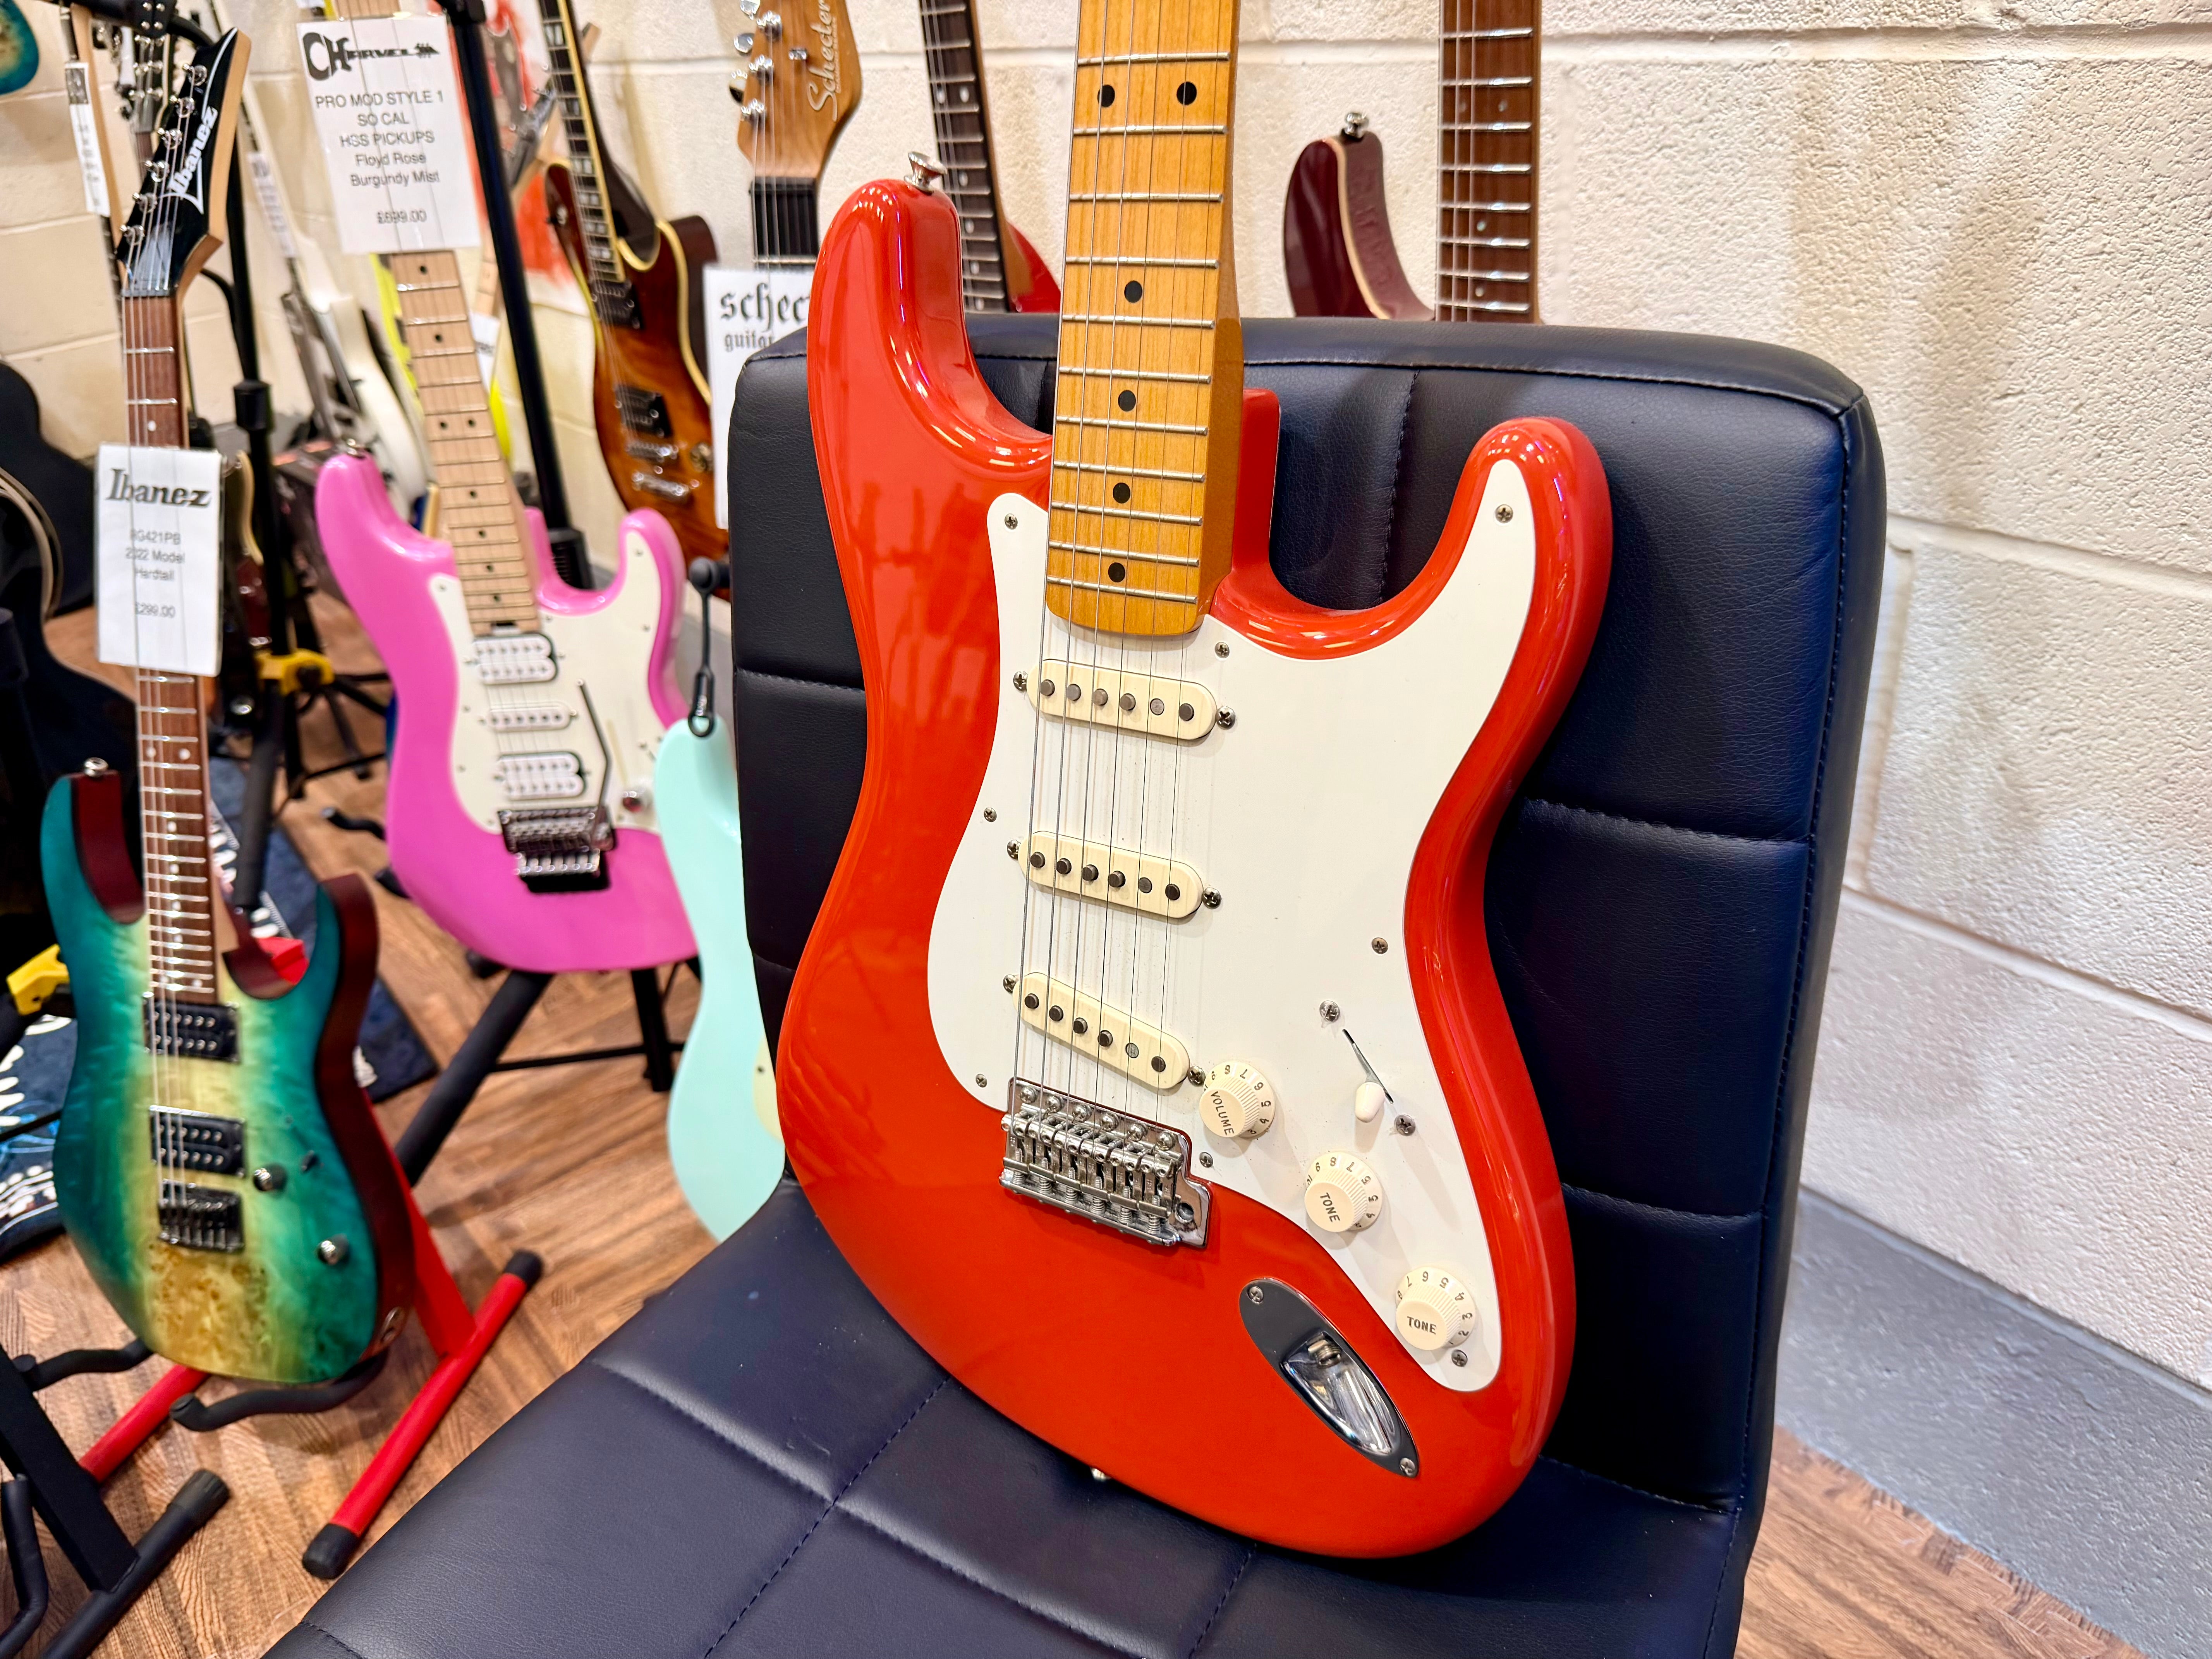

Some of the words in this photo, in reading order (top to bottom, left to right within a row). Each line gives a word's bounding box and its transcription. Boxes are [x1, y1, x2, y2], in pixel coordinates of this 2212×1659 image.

[315, 94, 347, 108] PRO
[350, 93, 383, 106] MOD
[386, 91, 432, 105] STYLE
[436, 90, 444, 103] 1
[357, 113, 378, 127] SO
[381, 111, 409, 125] CAL
[339, 134, 369, 147] HSS
[373, 130, 435, 145] PICKUPS
[167, 106, 218, 195] Ibanez
[355, 154, 390, 168] Floyd
[393, 153, 426, 165] Rose
[350, 171, 409, 188] Burgundy
[412, 169, 440, 183] Mist
[105, 468, 211, 508] Ibanez
[1224, 1065, 1231, 1074] 8
[1240, 1069, 1248, 1079] 7
[1254, 1082, 1264, 1091] 6
[1211, 1091, 1235, 1135] VOLUME
[1315, 1162, 1321, 1172] 9
[1330, 1157, 1337, 1166] 8
[1346, 1162, 1355, 1172] 7
[1361, 1176, 1371, 1185] 6
[1320, 1192, 1340, 1223] TONE
[1407, 1276, 1412, 1288] 7
[1422, 1271, 1429, 1282] 6
[1439, 1277, 1449, 1289] 5
[1455, 1292, 1465, 1301] 4
[1407, 1316, 1437, 1335] TONE
